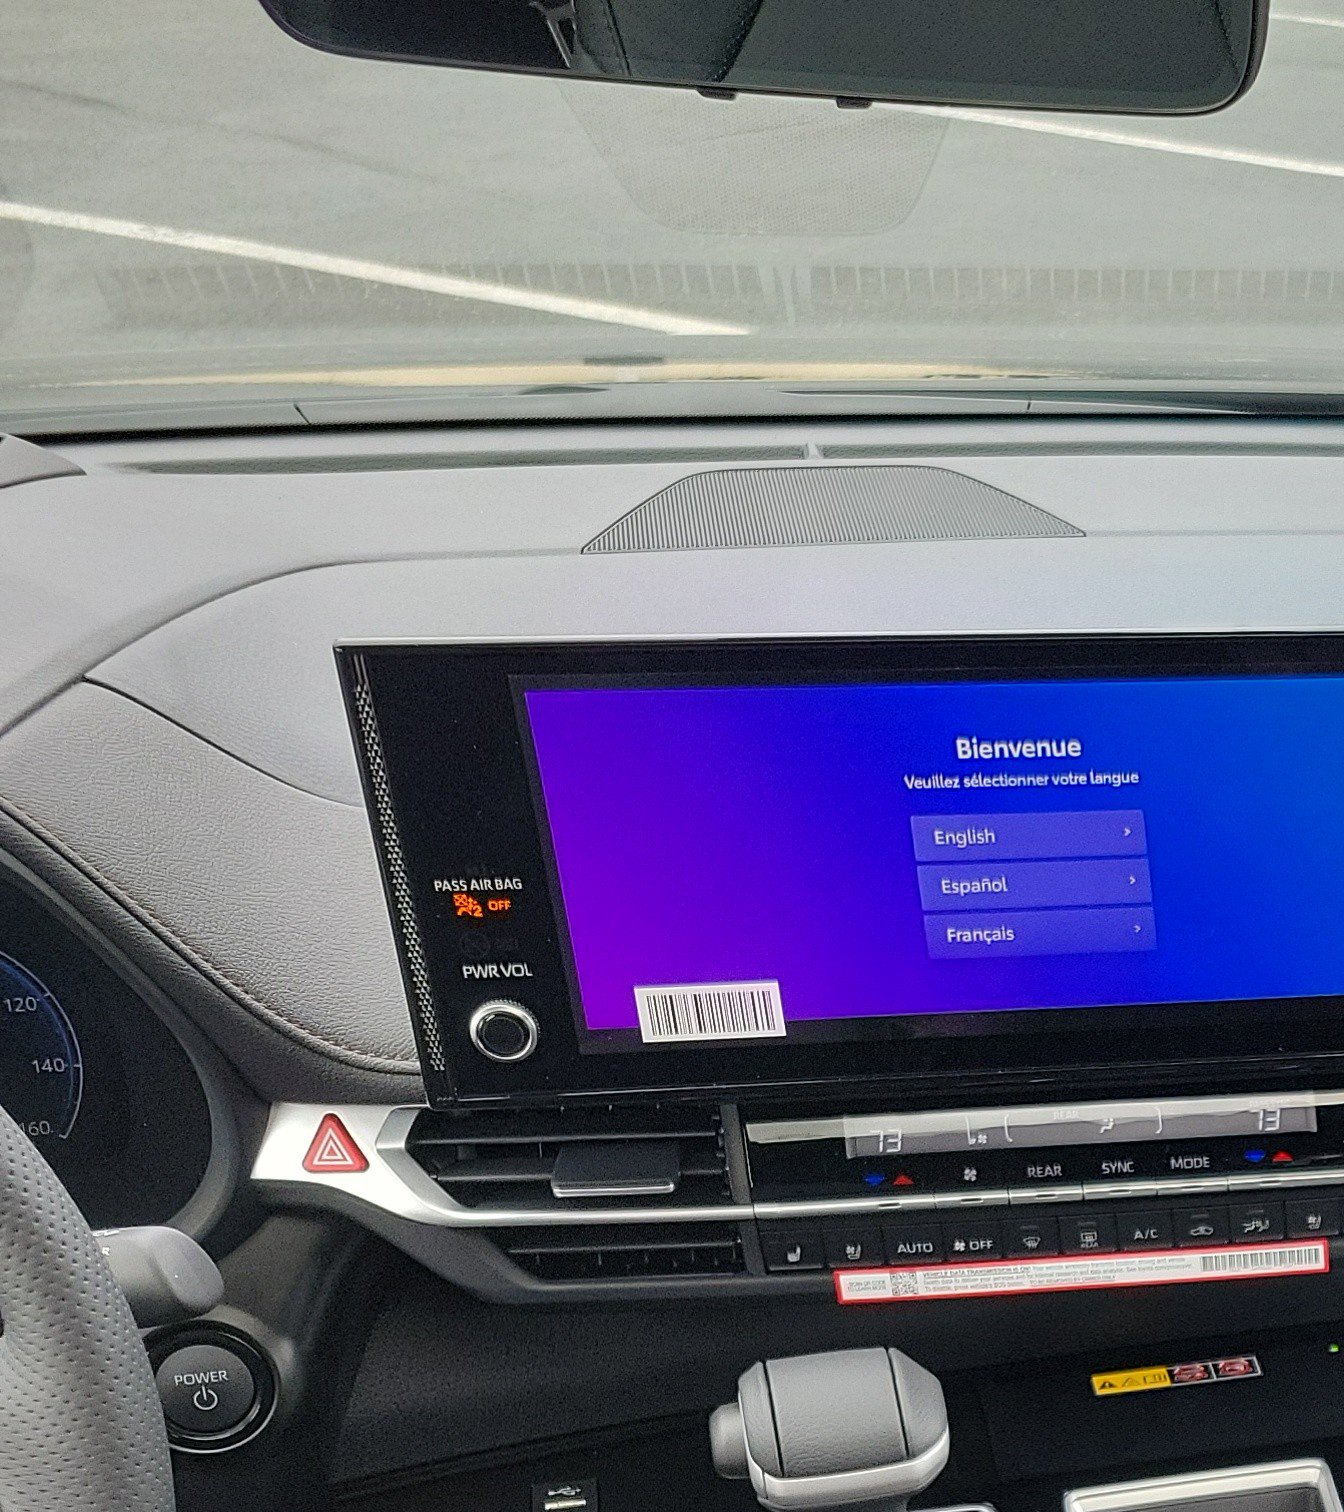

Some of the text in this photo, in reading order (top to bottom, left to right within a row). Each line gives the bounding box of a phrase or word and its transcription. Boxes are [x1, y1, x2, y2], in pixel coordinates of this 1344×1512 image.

[956, 736, 1082, 759] Bienvenue
[904, 768, 1139, 789] Veuillez sélectionner votre langue
[934, 828, 996, 848] English
[434, 878, 523, 892] PASS AIR BAG
[941, 877, 1008, 897] Español
[487, 900, 511, 911] OFF
[947, 926, 1015, 945] Français
[462, 962, 533, 979] PWR VOL
[4, 996, 37, 1013] 120
[32, 1058, 65, 1074] 140
[19, 1121, 50, 1136] 160
[1101, 1161, 1135, 1174] SYNC
[1170, 1156, 1210, 1170] MODE
[1027, 1165, 1062, 1178] REAR
[1134, 1228, 1158, 1240] A/C
[897, 1242, 933, 1254] AUTO
[969, 1240, 994, 1250] OFF
[174, 1370, 228, 1386] POWER
